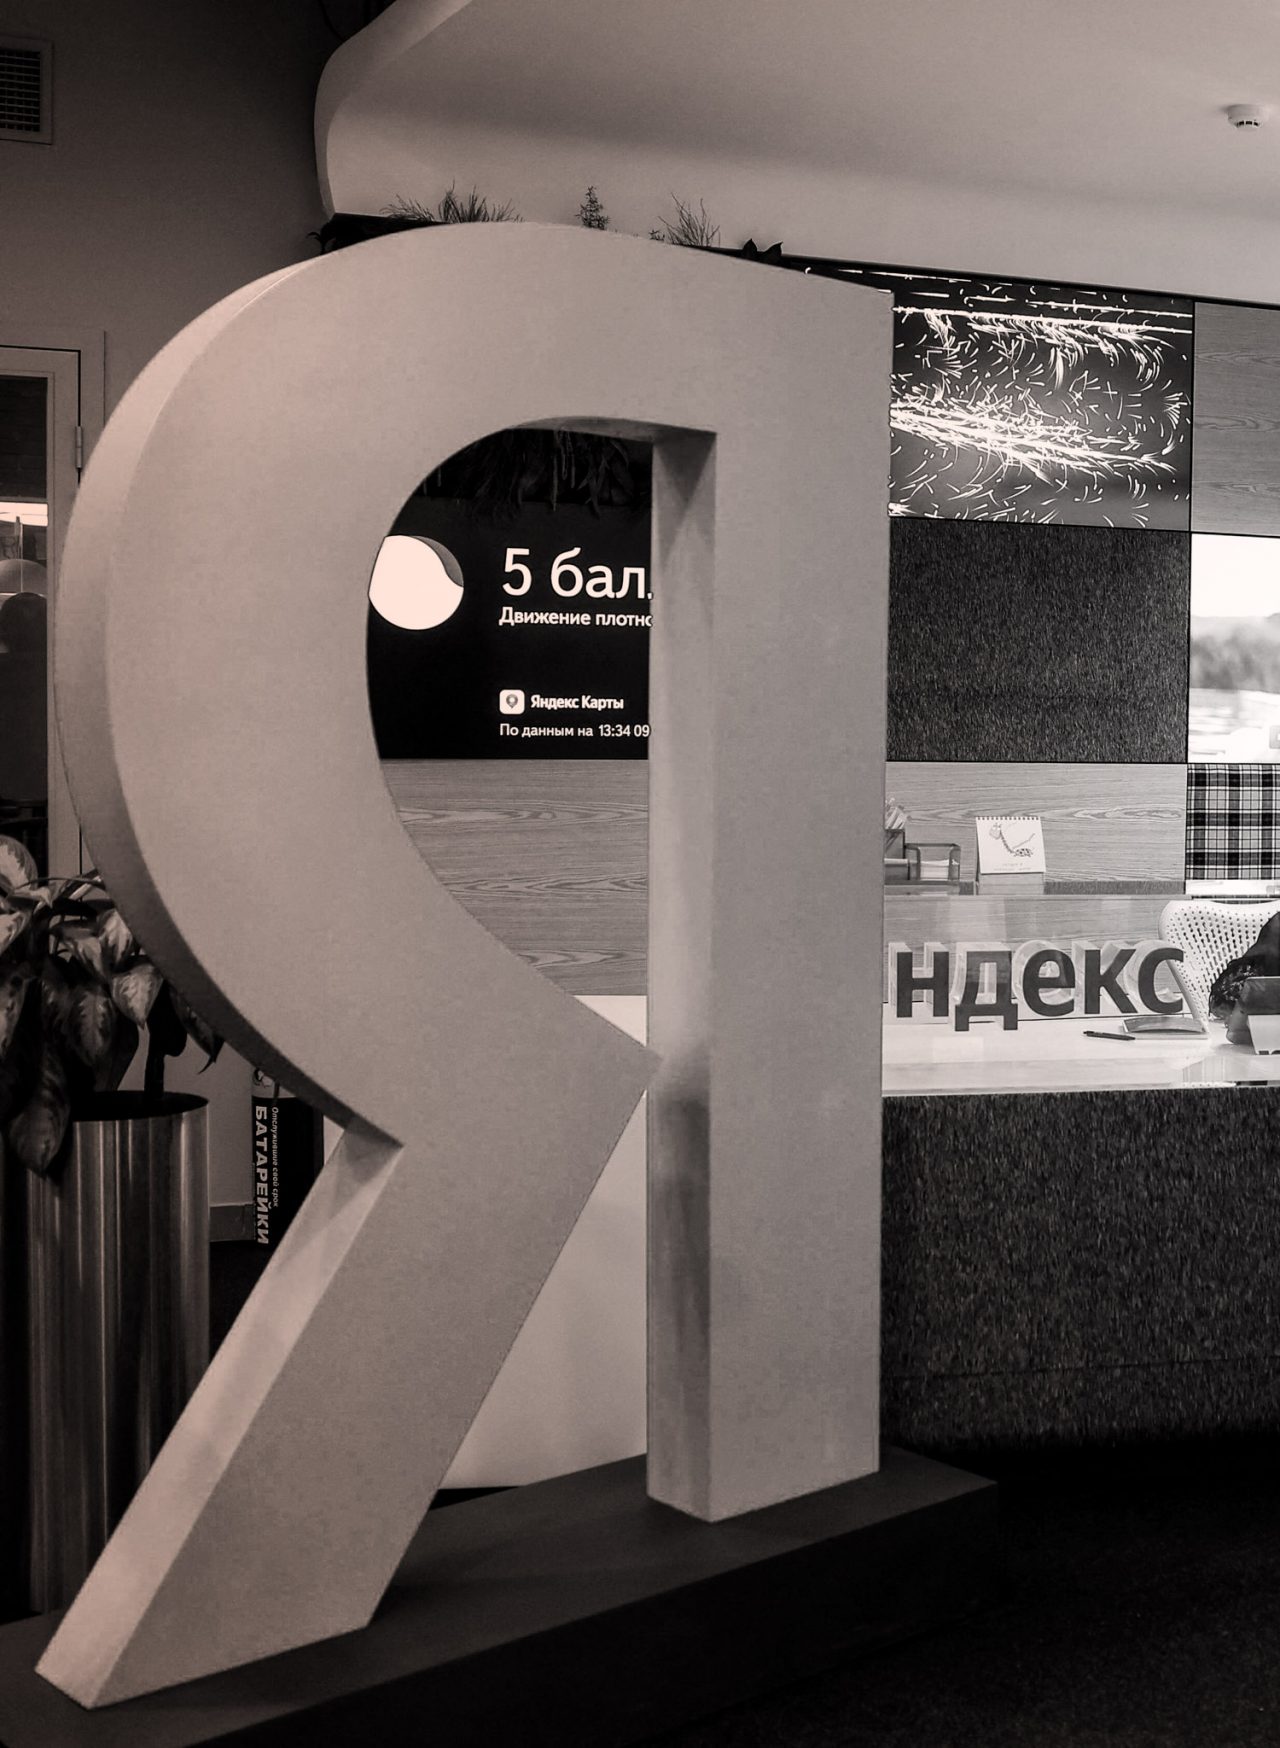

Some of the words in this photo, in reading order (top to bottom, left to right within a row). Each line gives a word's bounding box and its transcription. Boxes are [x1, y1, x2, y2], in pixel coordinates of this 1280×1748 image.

[502, 547, 532, 596] 5
[550, 547, 653, 599] бал
[499, 606, 591, 627] Движение
[530, 694, 580, 711] Яндекс
[581, 694, 624, 711] Карты
[499, 723, 519, 737] По
[521, 726, 574, 738] данным
[577, 727, 594, 737] на
[598, 724, 631, 737] 13:34
[36, 221, 894, 1709] Я
[255, 1105, 272, 1245] БАТАРЕЙКИ
[271, 1167, 280, 1187] свой
[271, 1188, 280, 1207] срок
